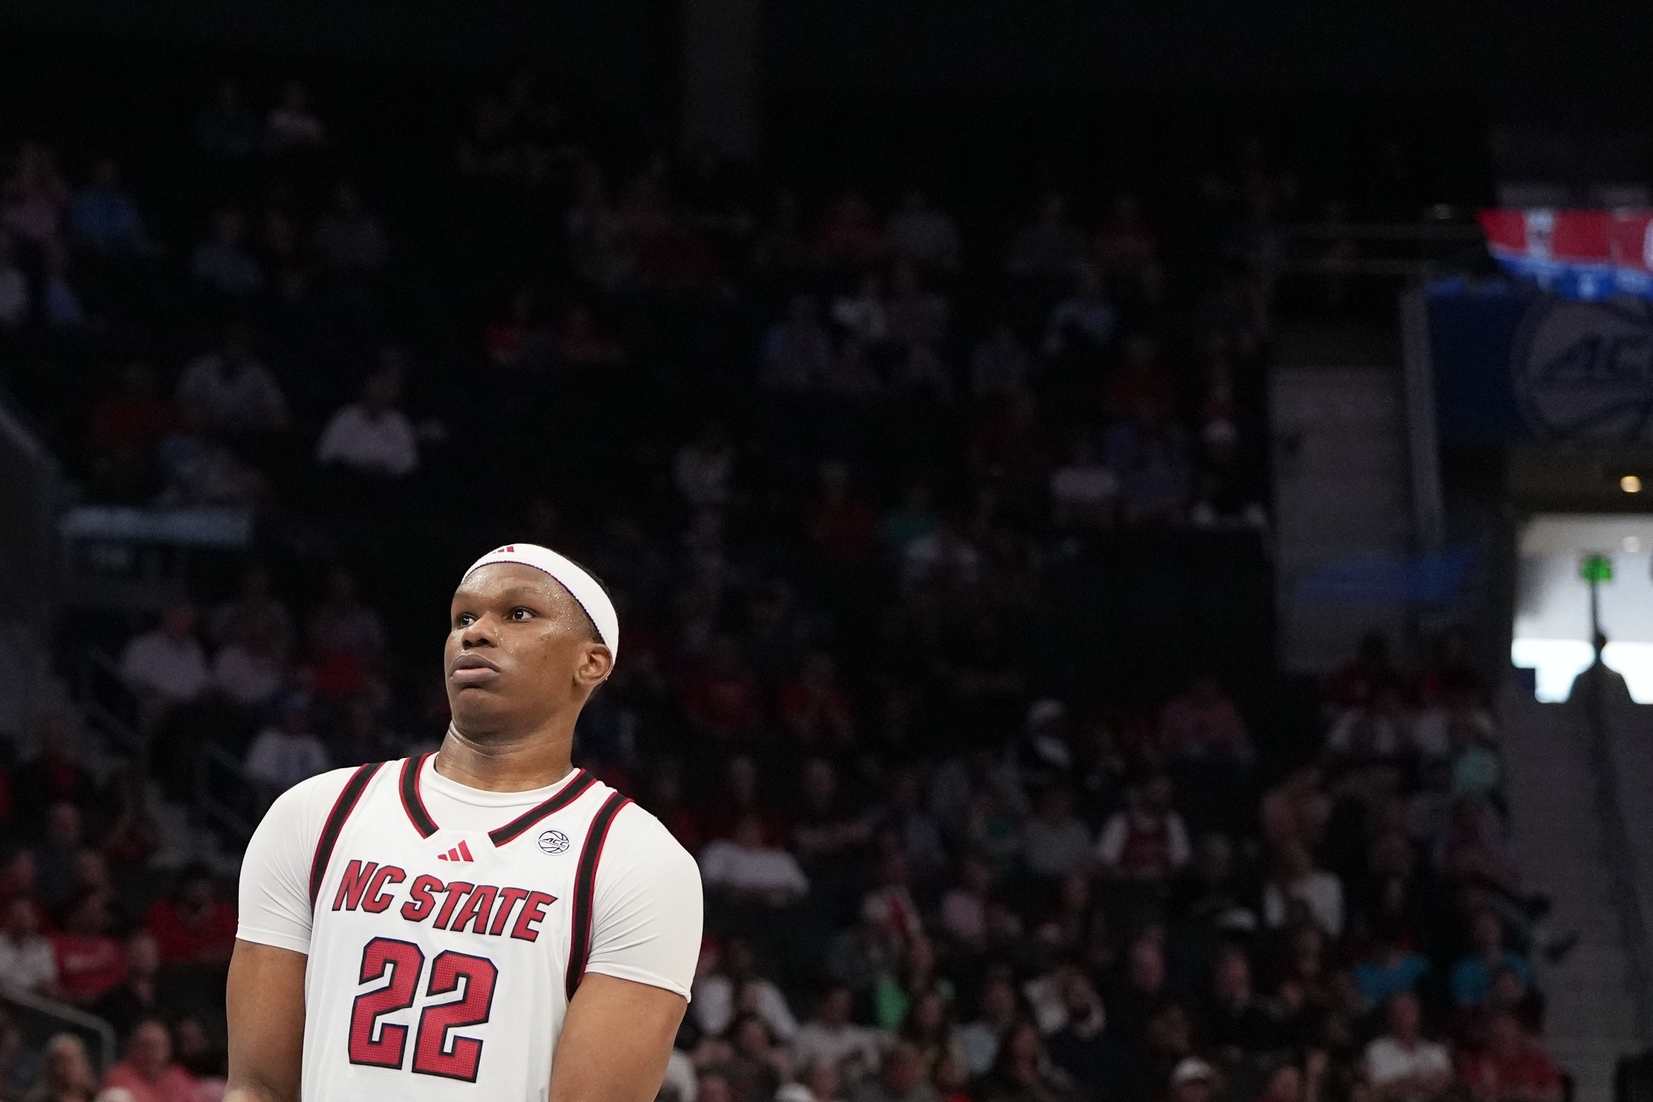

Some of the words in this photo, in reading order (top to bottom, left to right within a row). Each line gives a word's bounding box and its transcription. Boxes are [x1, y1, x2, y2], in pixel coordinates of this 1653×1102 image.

[332, 860, 406, 913] NC
[401, 874, 558, 942] STATE
[348, 936, 498, 1083] 22
